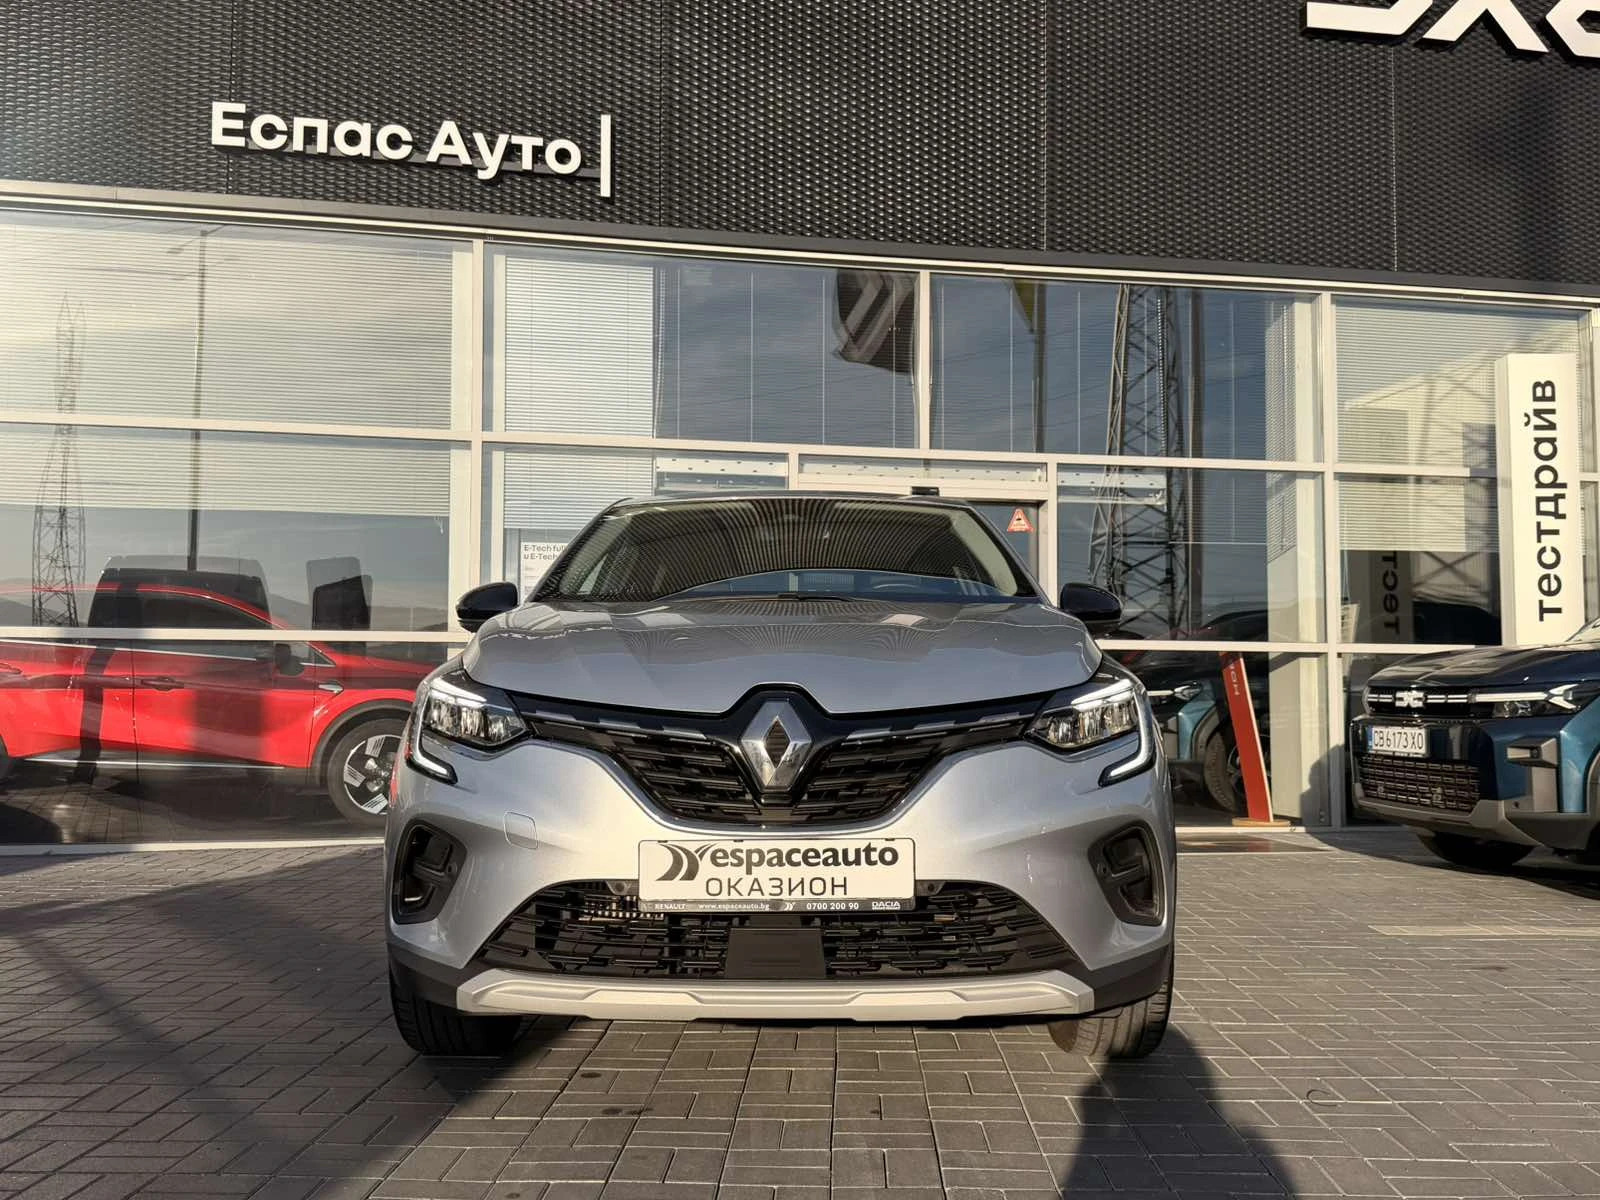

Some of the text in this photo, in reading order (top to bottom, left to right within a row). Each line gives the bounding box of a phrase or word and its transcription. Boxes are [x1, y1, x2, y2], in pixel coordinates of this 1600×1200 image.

[211, 101, 582, 180] Еспас Ауто
[1523, 379, 1568, 622] тестдрайв
[709, 841, 899, 875] espaceauto
[705, 876, 848, 897] ОКАЗИОН
[654, 903, 686, 911] RENAULT
[697, 902, 770, 912] www.espaceauto.bg
[806, 902, 828, 911] 0700
[829, 902, 846, 911] 200
[848, 902, 860, 911] 90
